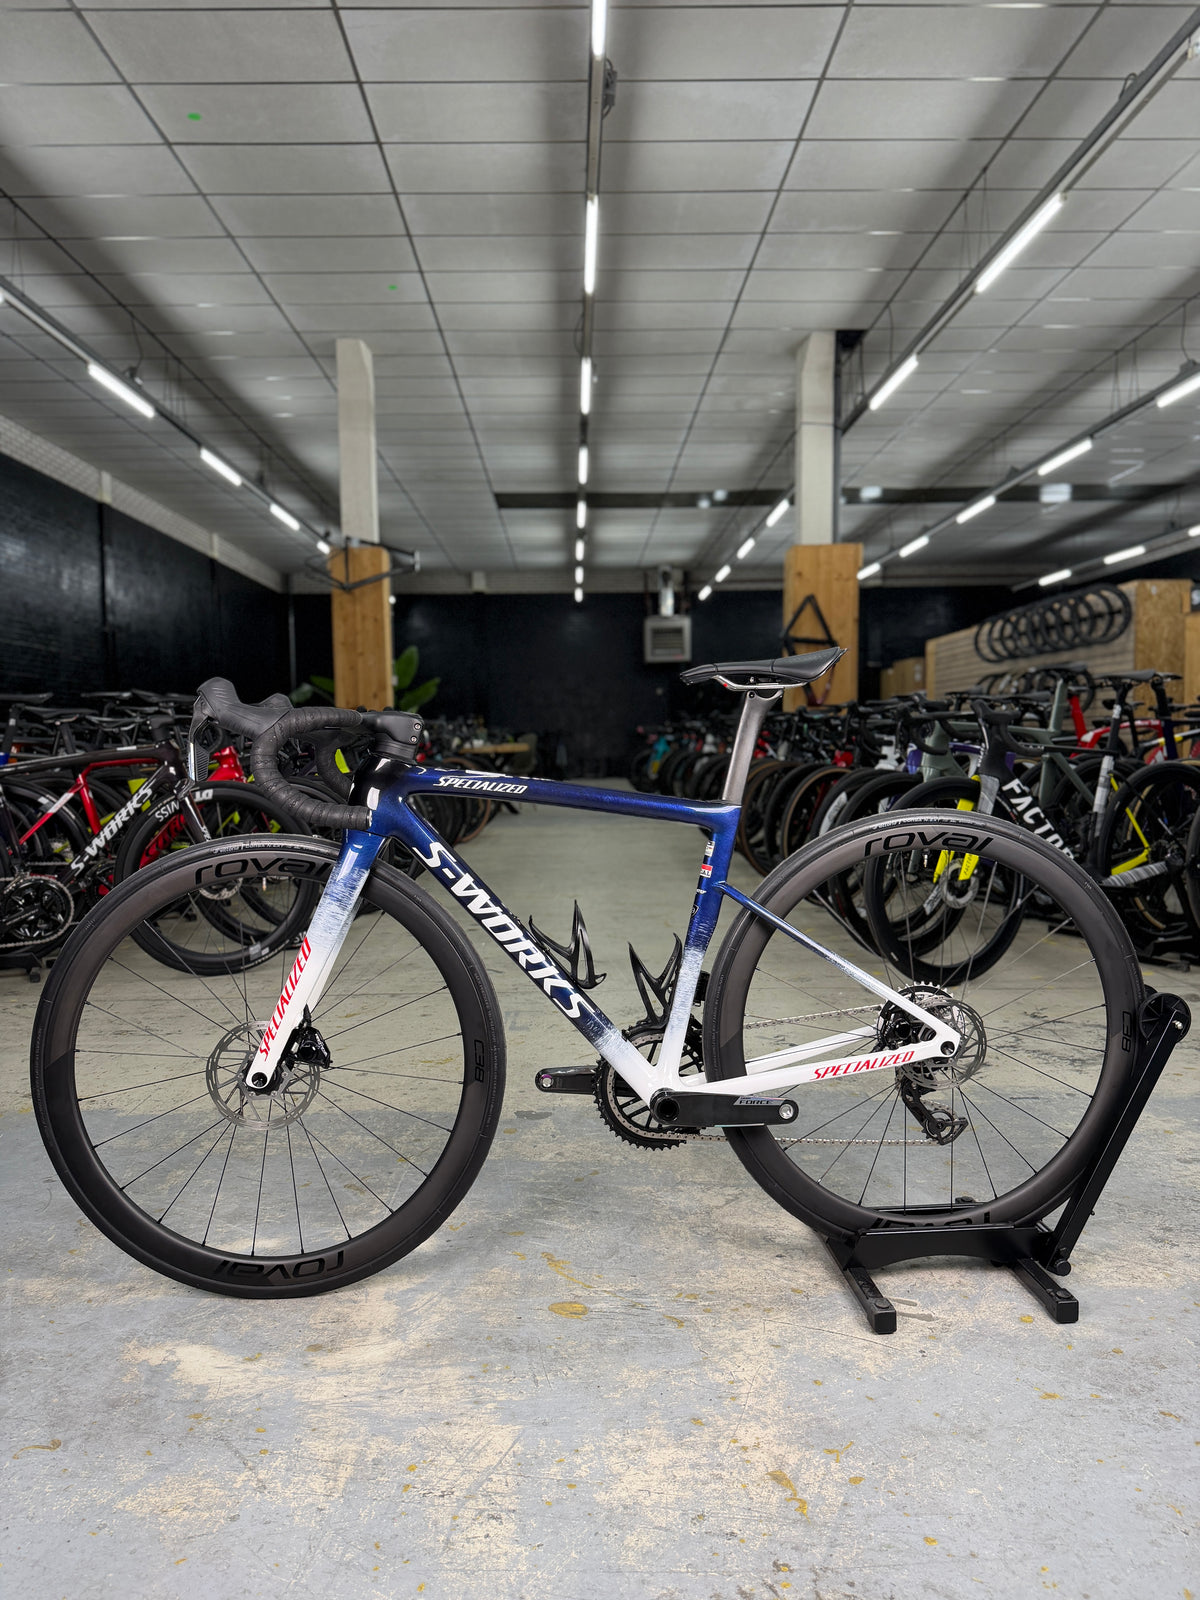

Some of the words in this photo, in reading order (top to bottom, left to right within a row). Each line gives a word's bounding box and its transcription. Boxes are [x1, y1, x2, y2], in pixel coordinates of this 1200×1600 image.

[433, 775, 528, 794] SPECIALIZED
[70, 778, 154, 877] S-WORKS
[865, 831, 994, 857] roval
[195, 857, 331, 885] roval
[412, 841, 596, 1019] S-WORKS
[259, 936, 312, 1062] SPECIALIZED
[809, 1050, 915, 1081] SPECIALIZED
[213, 1249, 345, 1279] roval
